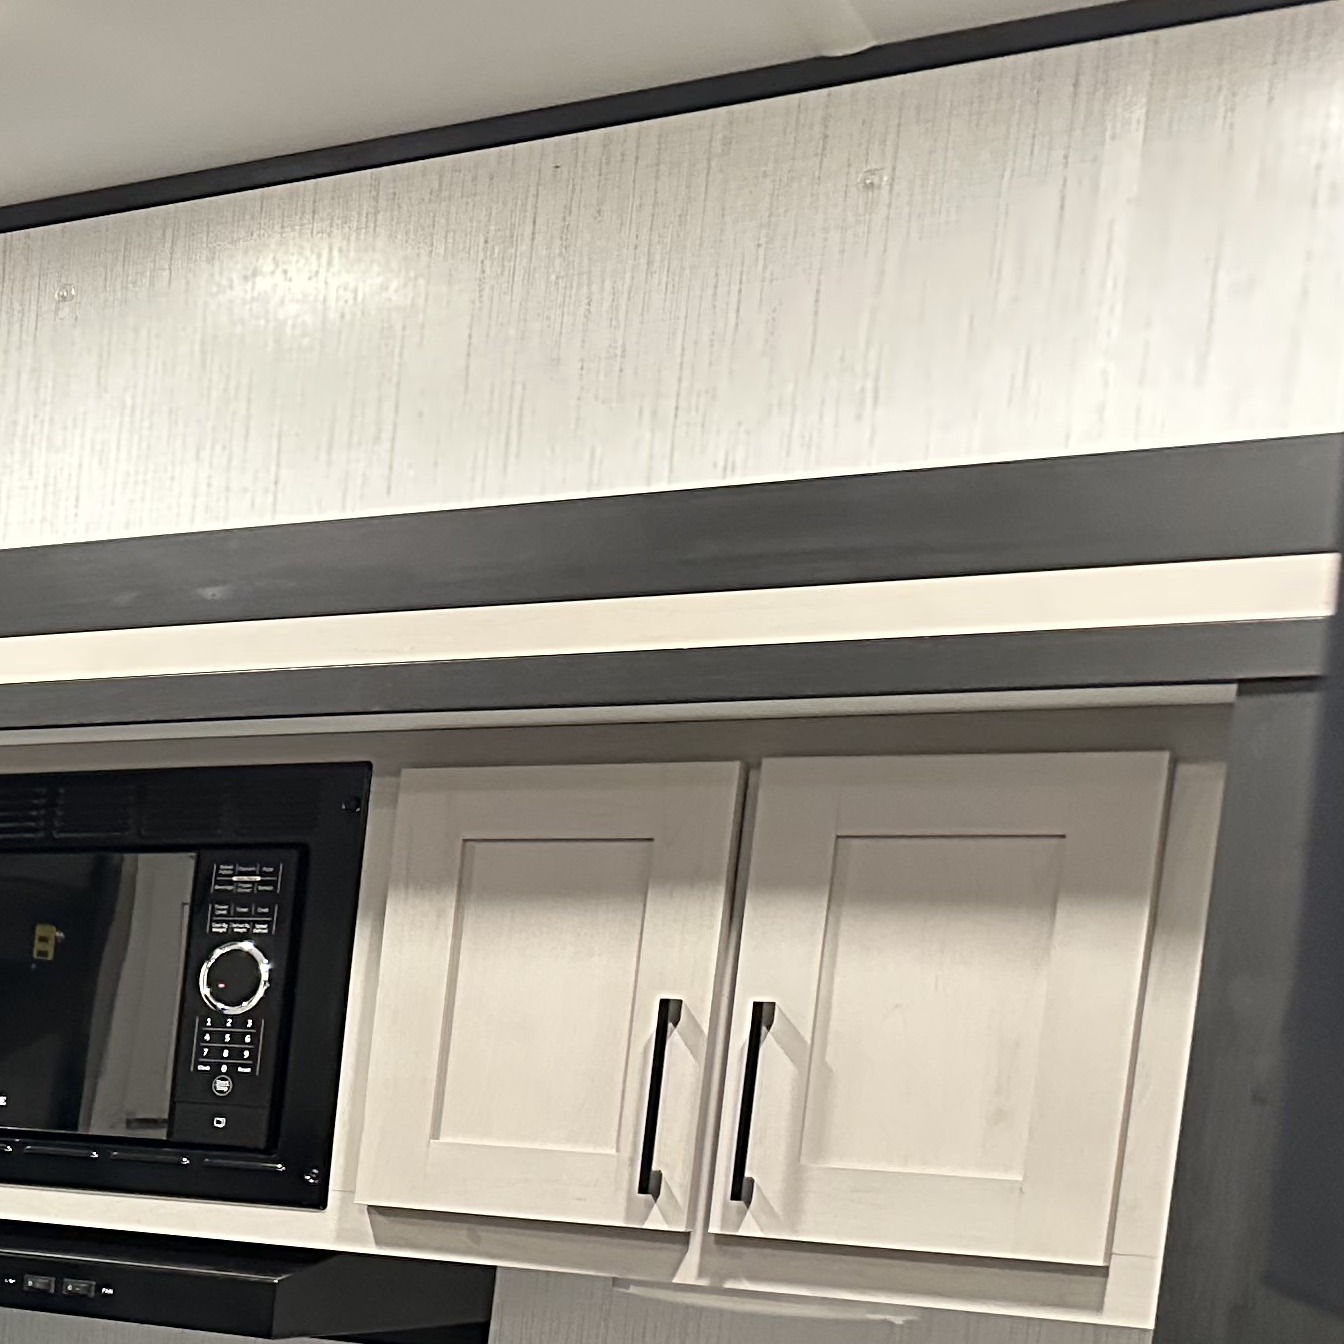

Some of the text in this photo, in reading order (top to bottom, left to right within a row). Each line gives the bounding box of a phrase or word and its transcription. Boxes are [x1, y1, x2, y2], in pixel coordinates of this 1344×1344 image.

[206, 1017, 253, 1028] 1 2 3
[204, 1033, 251, 1043] 4 5 6
[203, 1047, 250, 1059] 7 8 9
